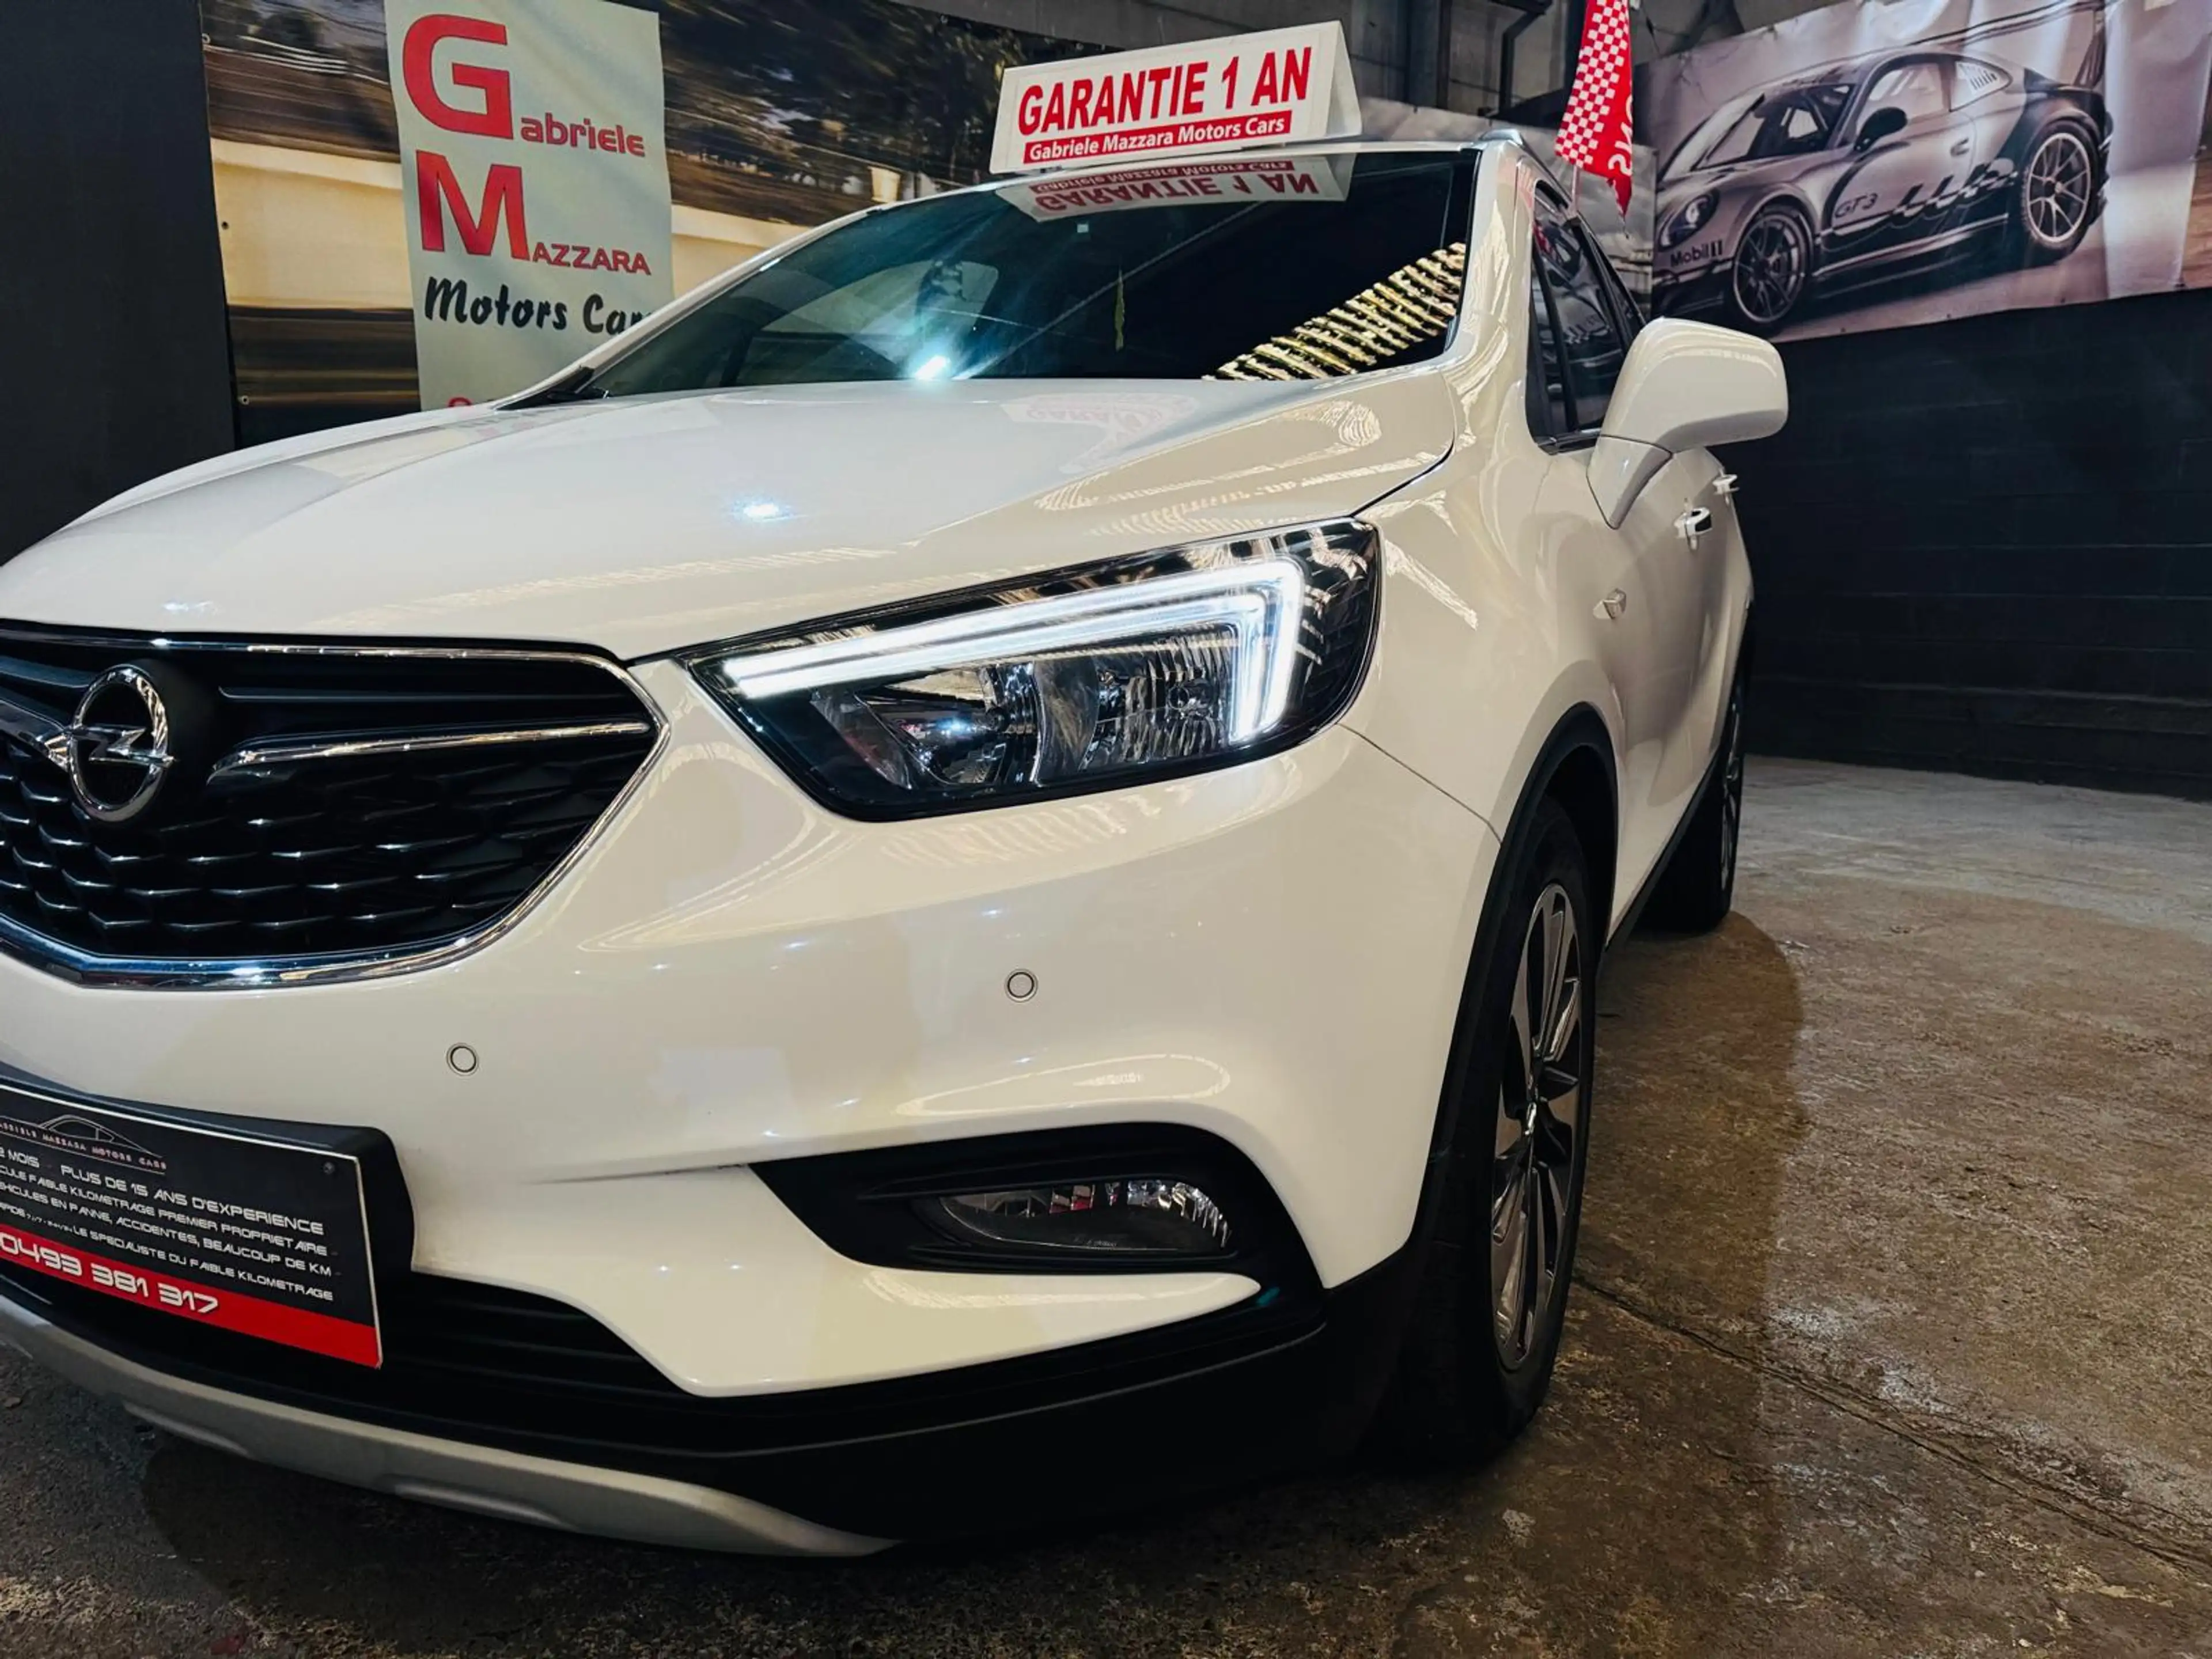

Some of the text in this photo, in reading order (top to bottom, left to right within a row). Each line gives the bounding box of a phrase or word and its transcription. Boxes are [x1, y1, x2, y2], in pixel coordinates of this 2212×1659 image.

[1018, 47, 1311, 135] GARANTIE 1 AN
[1030, 116, 1285, 160] Gabriele Mazzara Motors Cars
[1834, 192, 1878, 218] GT3
[425, 276, 567, 330] Motors
[7, 1149, 39, 1168] MOIS
[60, 1165, 101, 1184] PLUS
[105, 1176, 127, 1192] DE
[131, 1183, 149, 1197] 15
[154, 1188, 187, 1206] ANS
[191, 1196, 324, 1235] D'EXPERIENCE
[29, 1175, 67, 1193] FAIBLE
[70, 1186, 155, 1216] KILOMETRAGE
[158, 1209, 217, 1232] PREMIER
[221, 1224, 328, 1256] PROPRIETAIRE
[0, 1232, 218, 1314] 0493 381 317
[51, 1196, 67, 1210] EN
[203, 1238, 281, 1263] BEAUCOUP
[285, 1257, 305, 1270] DE
[309, 1262, 332, 1277] KM
[73, 1226, 87, 1237] LE
[90, 1230, 166, 1260] SPECIALISTE
[169, 1253, 186, 1265] DU
[190, 1259, 235, 1278] FAIBLE
[238, 1270, 334, 1301] KILOMETRAGE
